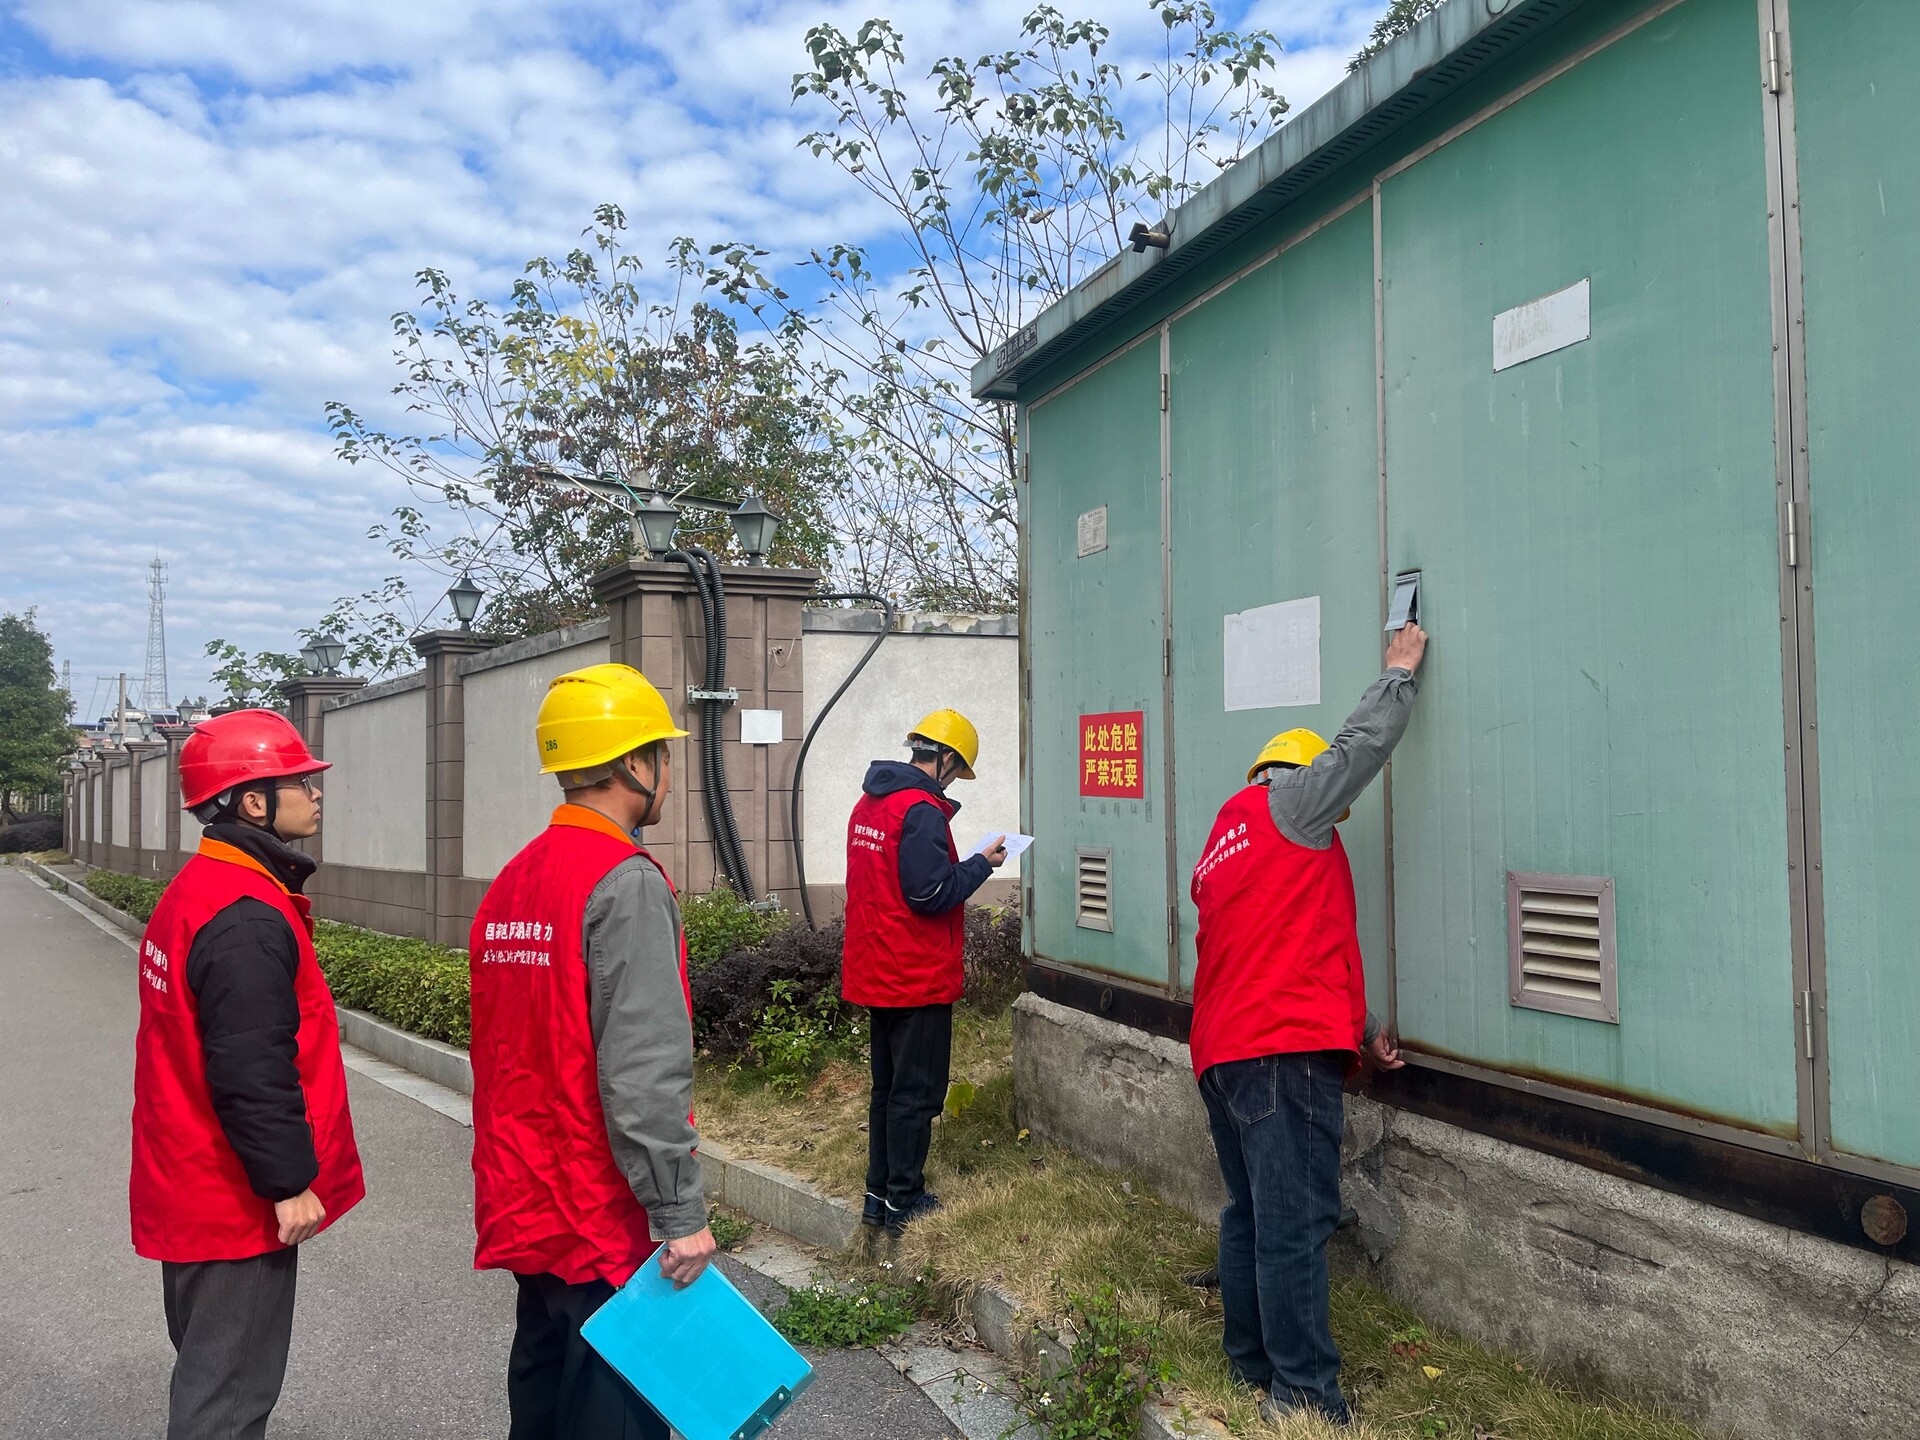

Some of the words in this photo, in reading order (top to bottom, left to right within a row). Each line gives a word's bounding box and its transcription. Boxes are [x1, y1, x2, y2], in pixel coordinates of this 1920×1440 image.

[1084, 722, 1138, 752] 此处危险
[1084, 758, 1138, 788] 严禁玩耍
